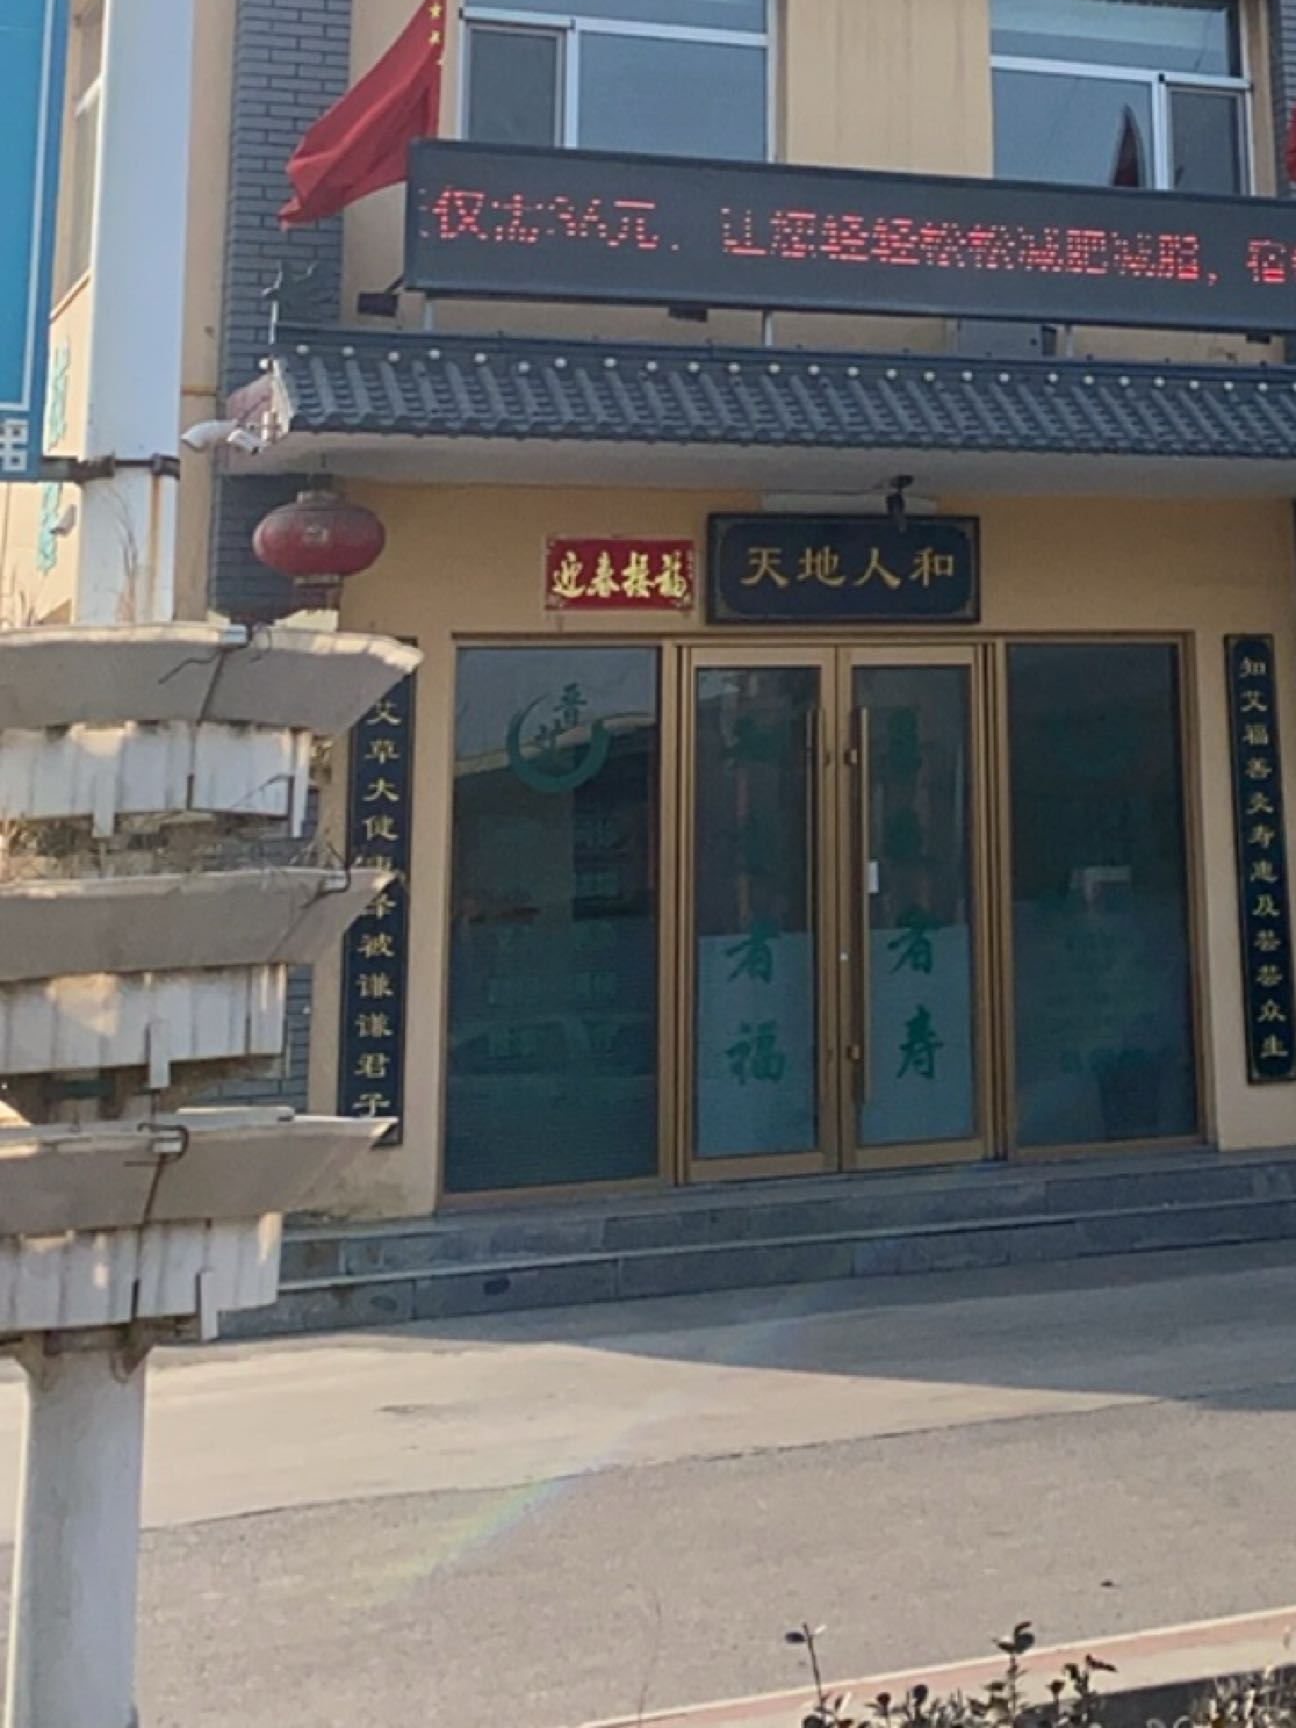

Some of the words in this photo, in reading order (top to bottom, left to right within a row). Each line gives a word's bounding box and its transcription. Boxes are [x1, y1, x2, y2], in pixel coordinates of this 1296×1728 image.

[552, 551, 689, 600] 迎春接福
[740, 545, 956, 590] 天地人和
